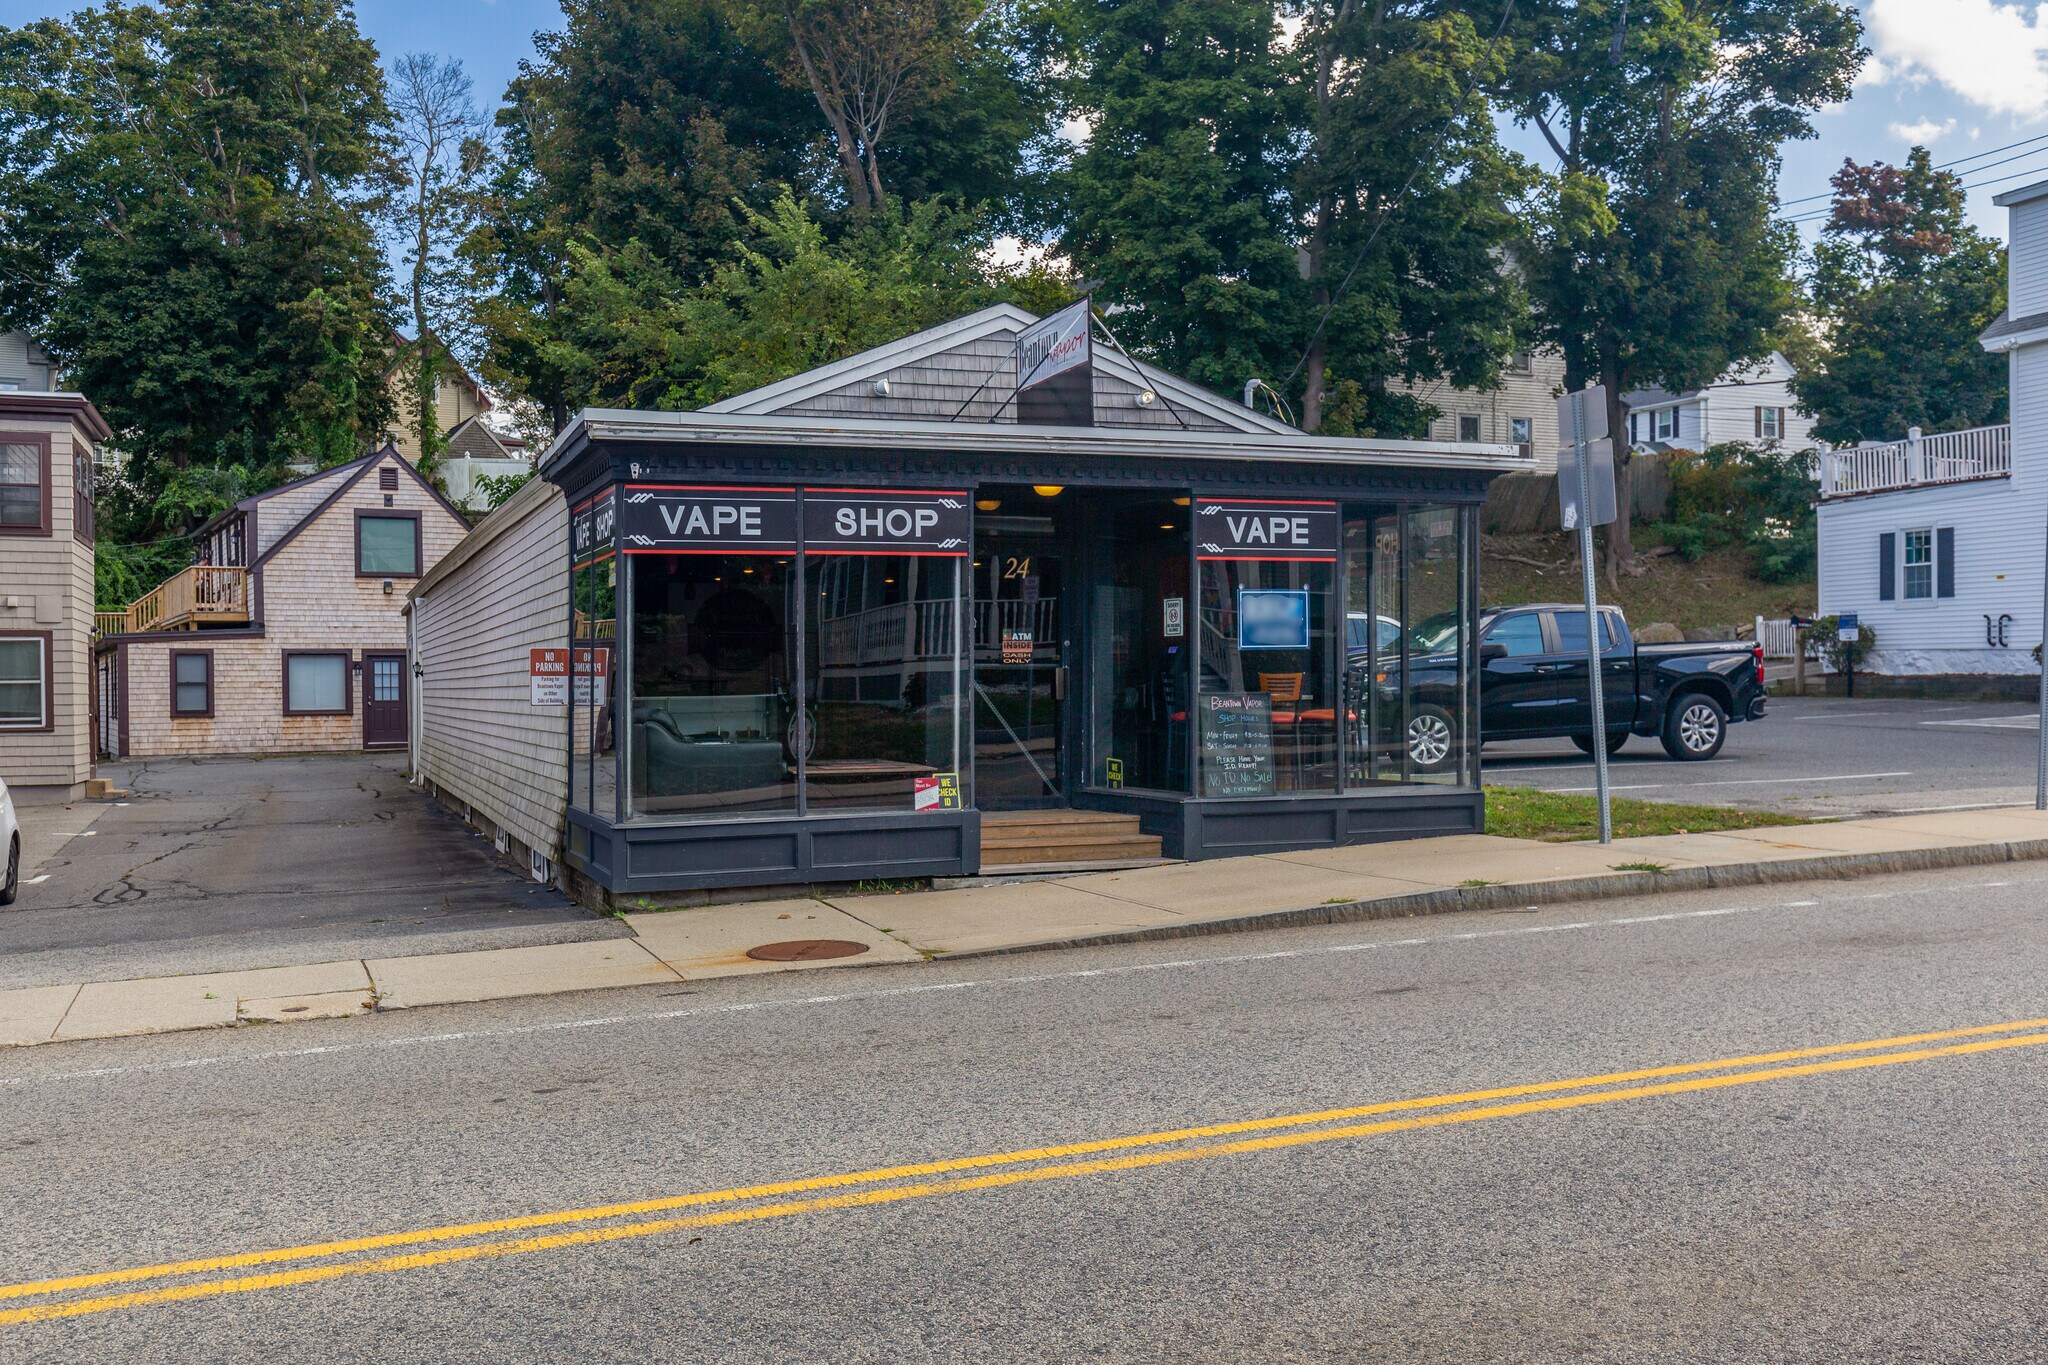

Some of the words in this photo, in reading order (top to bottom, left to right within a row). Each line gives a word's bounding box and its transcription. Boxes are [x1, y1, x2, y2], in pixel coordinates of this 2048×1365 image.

[597, 509, 613, 542] SHOP
[659, 505, 761, 535] VAPE
[835, 507, 939, 537] SHOP
[1226, 516, 1309, 544] VAPE
[1004, 557, 1030, 579] 24
[1003, 641, 1032, 650] INSIDE
[545, 652, 555, 662] NO
[535, 662, 564, 672] PARKING
[941, 778, 951, 787] WE
[944, 798, 951, 807] ID
